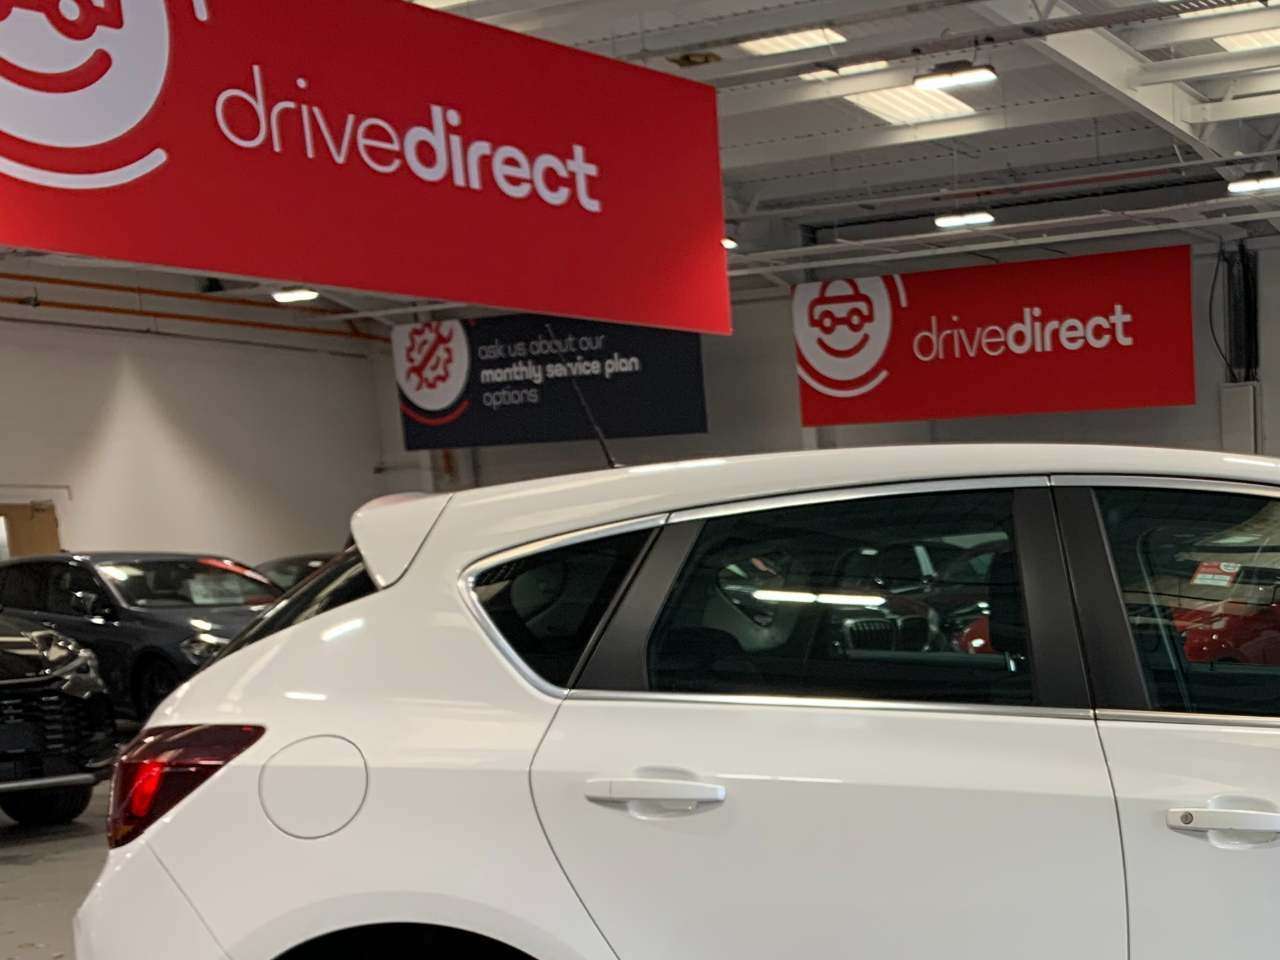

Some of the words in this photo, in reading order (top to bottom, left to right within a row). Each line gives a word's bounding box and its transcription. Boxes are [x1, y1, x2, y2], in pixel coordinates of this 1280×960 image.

[215, 64, 601, 213] drivedirect
[478, 338, 507, 360] ask
[507, 341, 527, 358] us
[528, 334, 577, 355] about
[578, 334, 605, 351] our
[912, 304, 1134, 362] drivedirect
[480, 360, 543, 384] monthly
[545, 355, 601, 379] service
[604, 352, 640, 378] plan
[482, 385, 539, 410] options
